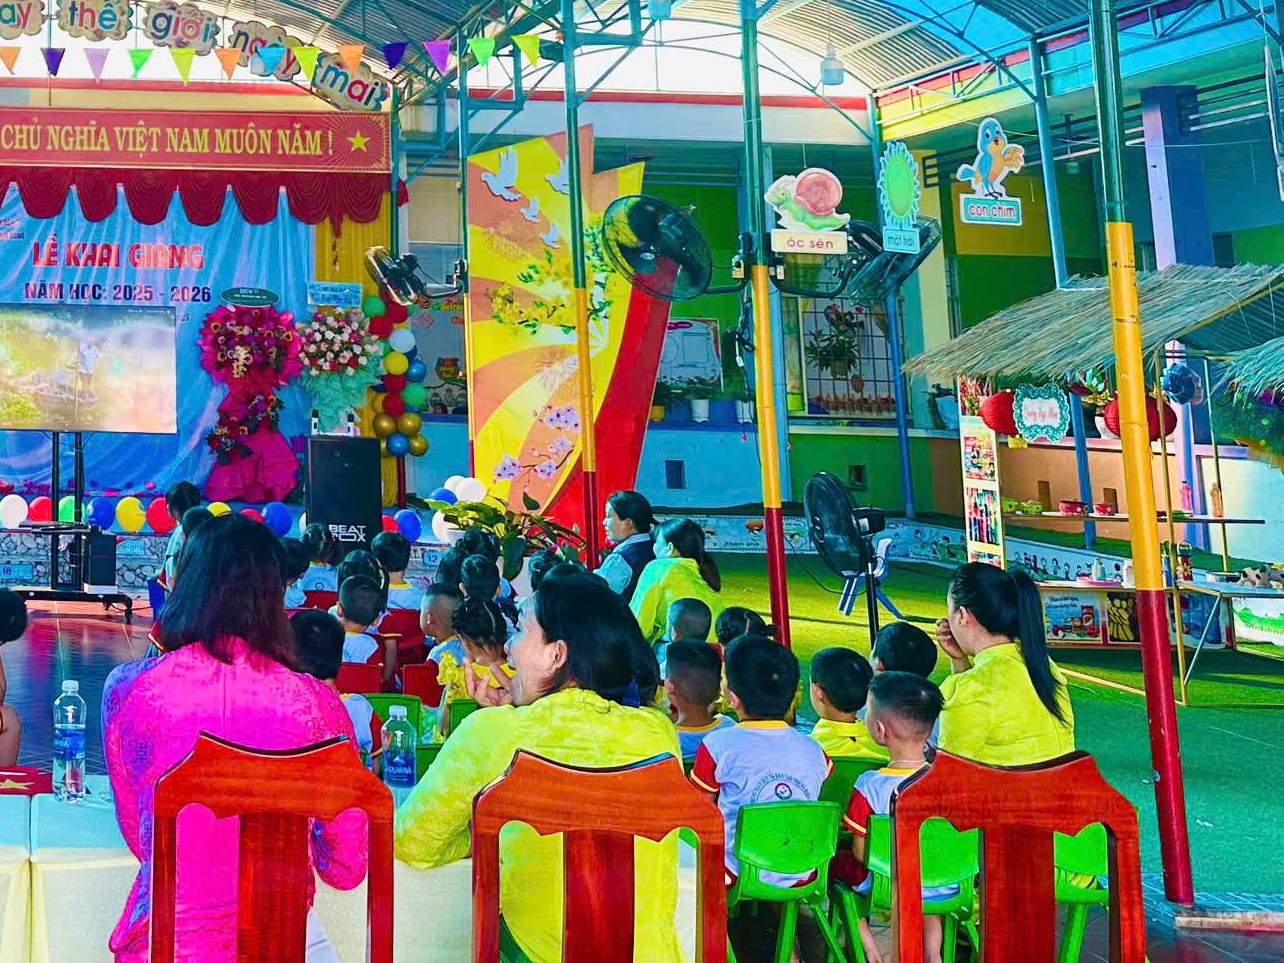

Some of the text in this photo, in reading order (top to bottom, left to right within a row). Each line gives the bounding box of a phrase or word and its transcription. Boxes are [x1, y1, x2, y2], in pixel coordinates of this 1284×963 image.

[151, 9, 213, 43] giới
[321, 63, 380, 106] mai
[0, 117, 41, 150] CHỦ
[46, 121, 110, 152] NGHĨA
[114, 120, 161, 158] VIỆT
[166, 127, 210, 154] NAM
[215, 121, 272, 155] MUÔN
[276, 123, 322, 156] NĂM
[970, 205, 1015, 218] con chim
[33, 232, 58, 267] LỄ
[66, 241, 120, 269] KHAI
[25, 279, 64, 300] NĂM
[69, 283, 108, 303] HỌC:
[112, 284, 153, 302] 2025
[170, 285, 211, 303] 2026
[329, 524, 366, 534] BEAT
[427, 554, 438, 562] 12
[2, 566, 12, 575] 18
